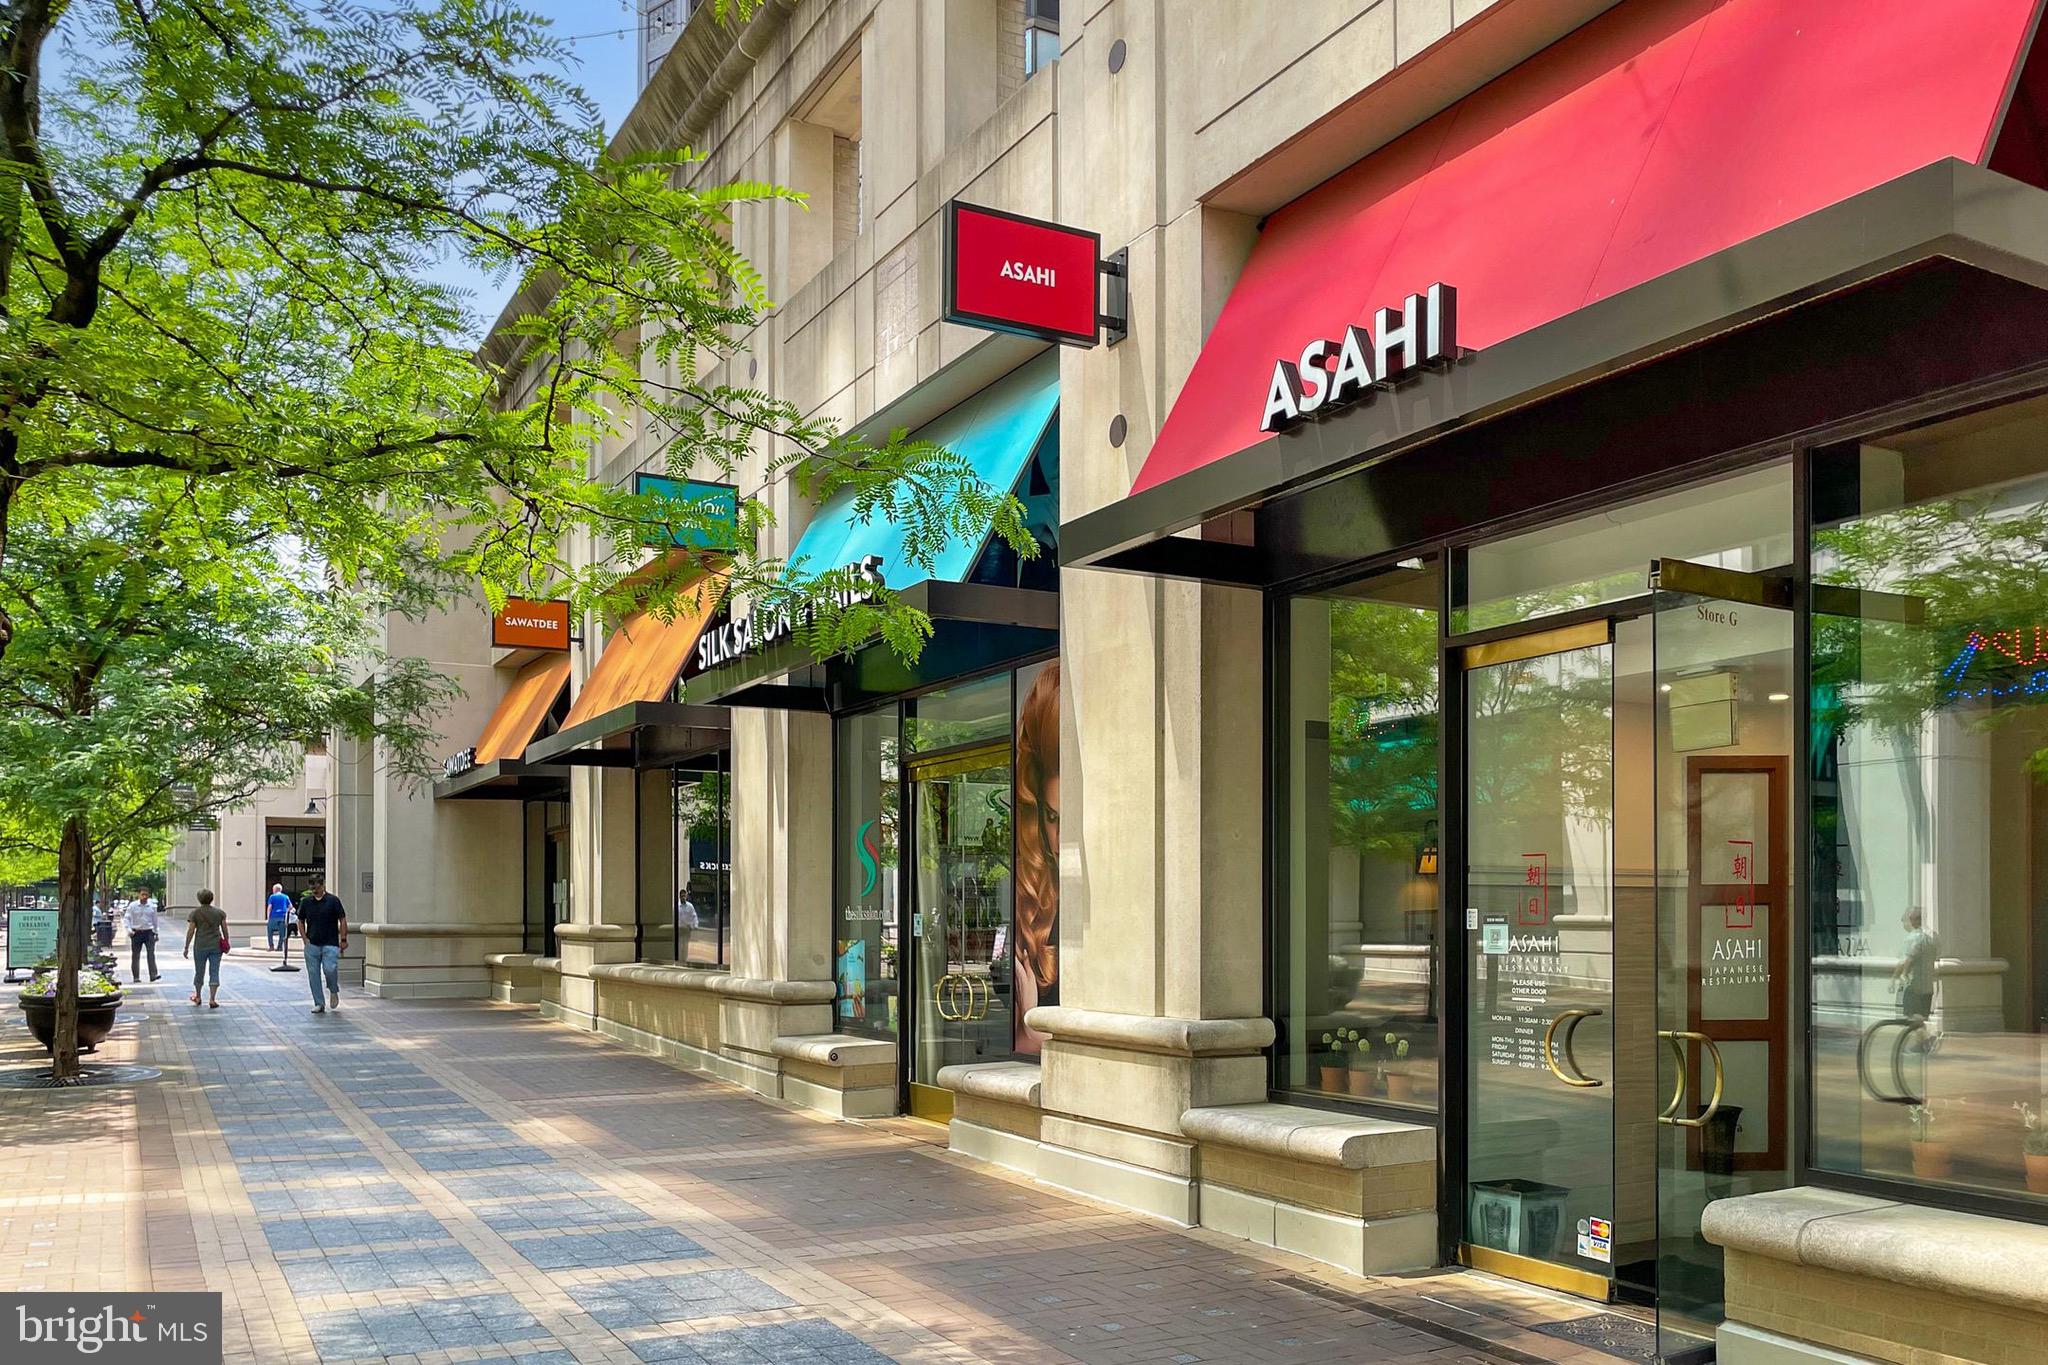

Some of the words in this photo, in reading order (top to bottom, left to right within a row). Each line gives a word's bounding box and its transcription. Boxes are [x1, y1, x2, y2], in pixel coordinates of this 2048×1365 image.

[1000, 259, 1056, 288] ASAHI
[1260, 282, 1456, 432] ASAHI
[1697, 604, 1725, 624] Store
[1728, 610, 1738, 627] G
[505, 616, 559, 630] SAWATDEE
[698, 622, 732, 670] SILK
[1508, 934, 1559, 953] ASAHI
[1711, 938, 1762, 961] ASAHI
[1505, 956, 1561, 965] JAPANESE
[1498, 964, 1569, 974] RESTAURANT
[1709, 964, 1764, 977] JAPANESE
[1512, 979, 1534, 987] PLEASE
[1701, 974, 1771, 987] RESTAURANT
[1511, 987, 1530, 995] OTHER
[1593, 1240, 1607, 1249] VISA
